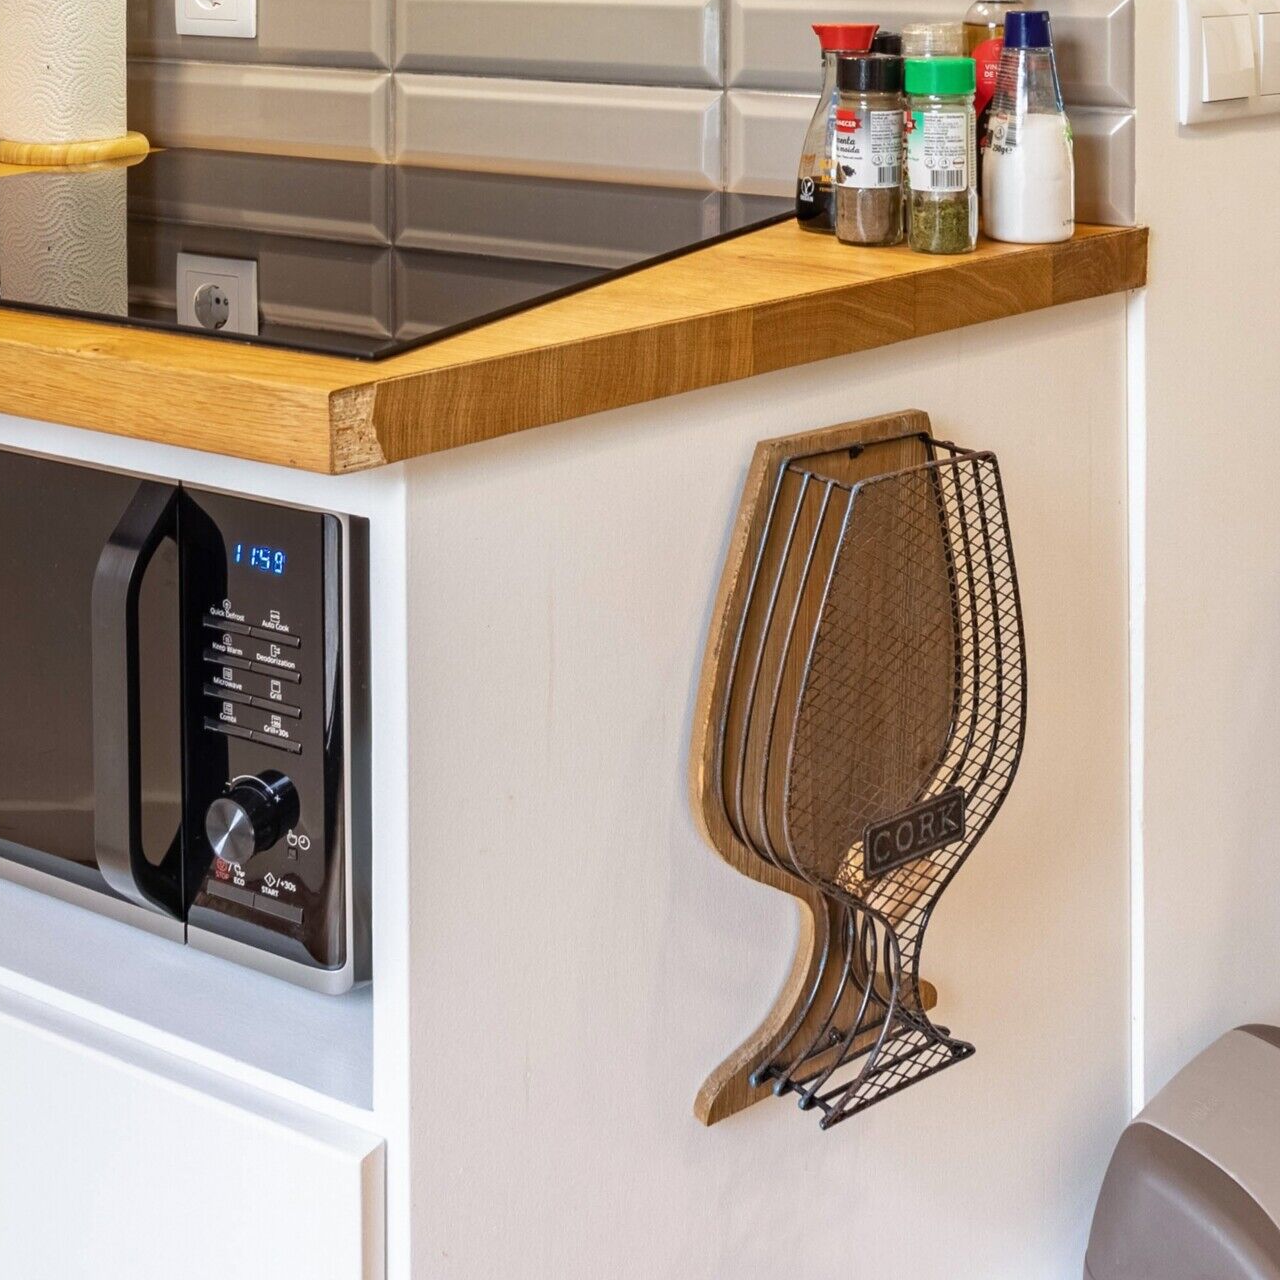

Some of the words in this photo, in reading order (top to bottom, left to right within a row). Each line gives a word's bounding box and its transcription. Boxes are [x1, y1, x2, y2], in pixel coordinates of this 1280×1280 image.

[261, 619, 275, 629] Auto
[275, 622, 289, 632] Cook
[212, 641, 226, 652] Keep
[227, 645, 243, 655] Warm
[256, 652, 296, 669] Deodorization
[213, 675, 243, 690] Microwave
[269, 691, 282, 701] Grill
[219, 712, 237, 723] Combi
[873, 800, 959, 864] CORK
[215, 871, 229, 880] STOP
[233, 876, 245, 887] ECO
[261, 885, 279, 897] START
